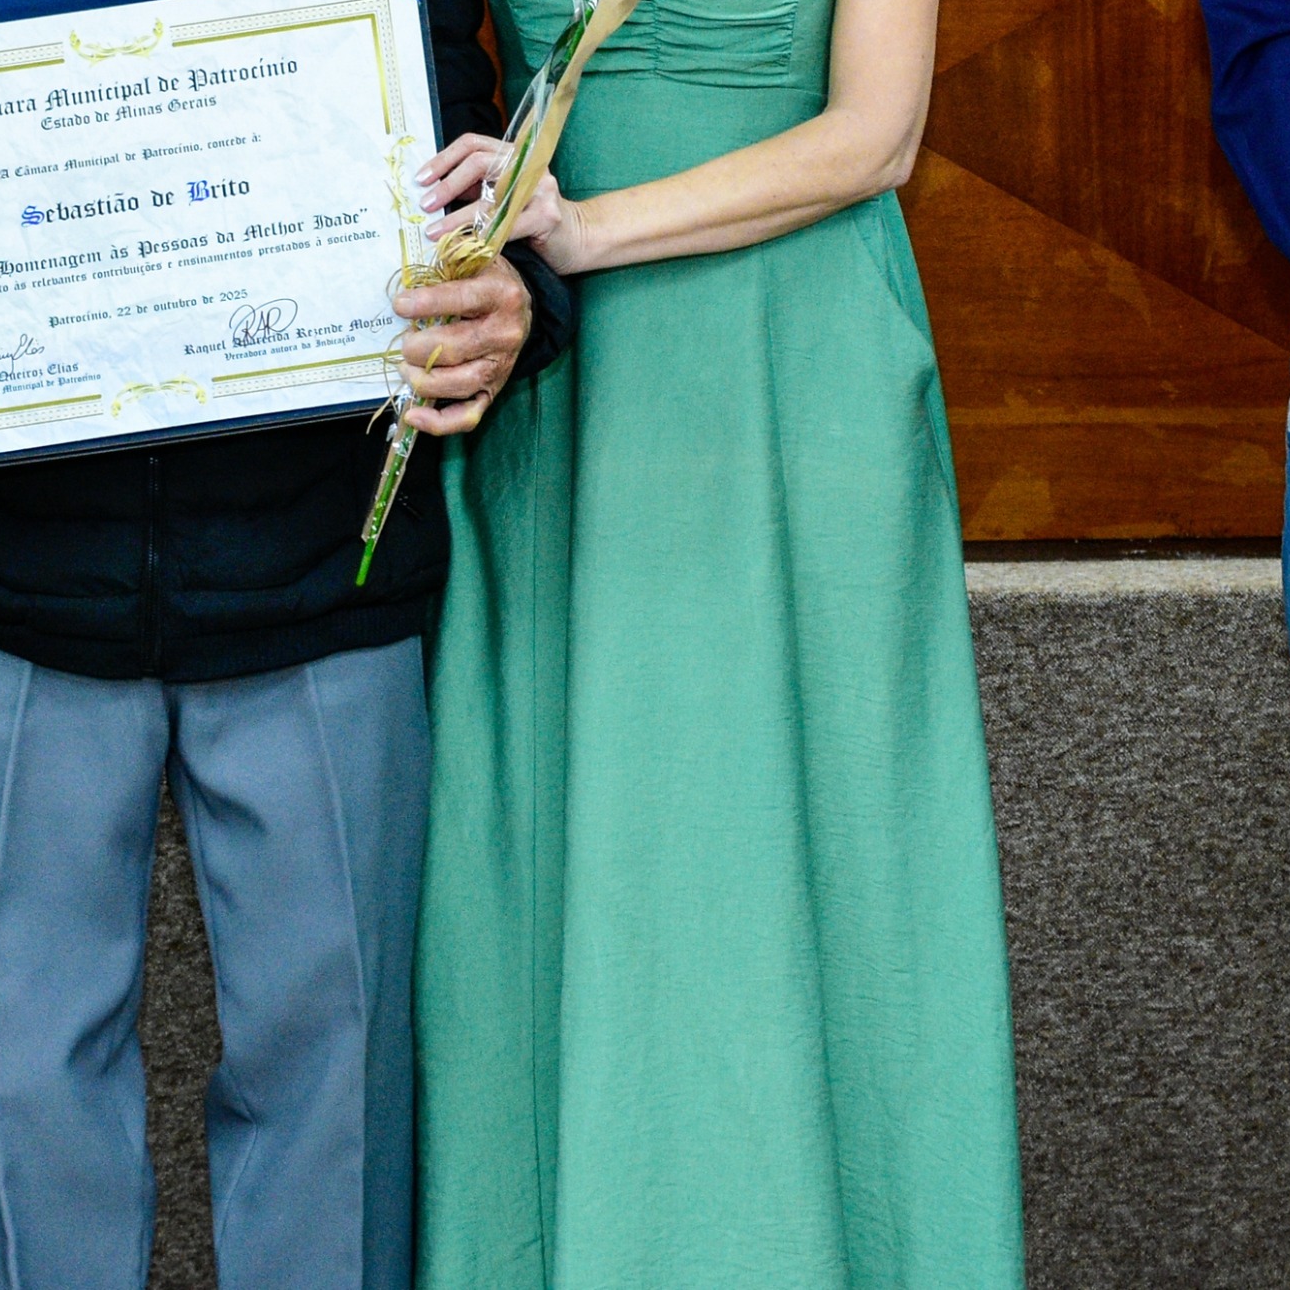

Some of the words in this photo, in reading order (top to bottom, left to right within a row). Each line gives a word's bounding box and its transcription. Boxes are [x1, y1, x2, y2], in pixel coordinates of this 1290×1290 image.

[44, 76, 151, 112] Municipal
[156, 75, 179, 92] de
[187, 56, 298, 92] Patrocínio
[40, 113, 90, 131] Estado
[94, 110, 109, 123] de
[114, 103, 163, 121] Minas
[167, 96, 217, 112] Gerais
[0, 168, 9, 179] A
[14, 163, 59, 177] Câmara
[63, 153, 120, 171] Municipal
[124, 152, 136, 161] de
[207, 136, 246, 149] concede
[251, 132, 261, 142] à:
[20, 192, 139, 227] Sebastião
[149, 189, 174, 207] de
[186, 178, 250, 206] Brito
[13, 280, 27, 291] às
[31, 273, 87, 288] relevantes
[91, 261, 162, 280] contribuições
[177, 249, 253, 267] ensinamentos
[258, 240, 311, 257] prestados
[326, 229, 380, 245] sociedade.
[109, 244, 129, 260] às
[137, 234, 208, 258] Pessoas
[215, 231, 235, 244] da
[242, 221, 304, 242] Melhor
[116, 305, 131, 317] 22
[135, 304, 148, 314] de
[153, 298, 197, 312] outubro
[201, 295, 214, 304] de
[219, 288, 248, 302] 2025
[183, 339, 226, 355] Raquel
[295, 323, 343, 339] Rezende
[348, 312, 393, 332] Morais
[224, 349, 267, 361] Vereadora
[270, 344, 298, 354] autora
[315, 334, 355, 348] Indicação
[2, 379, 44, 394] Municipal
[45, 379, 54, 387] de
[57, 373, 101, 386] Patrocínio
[46, 362, 78, 375] Elias
